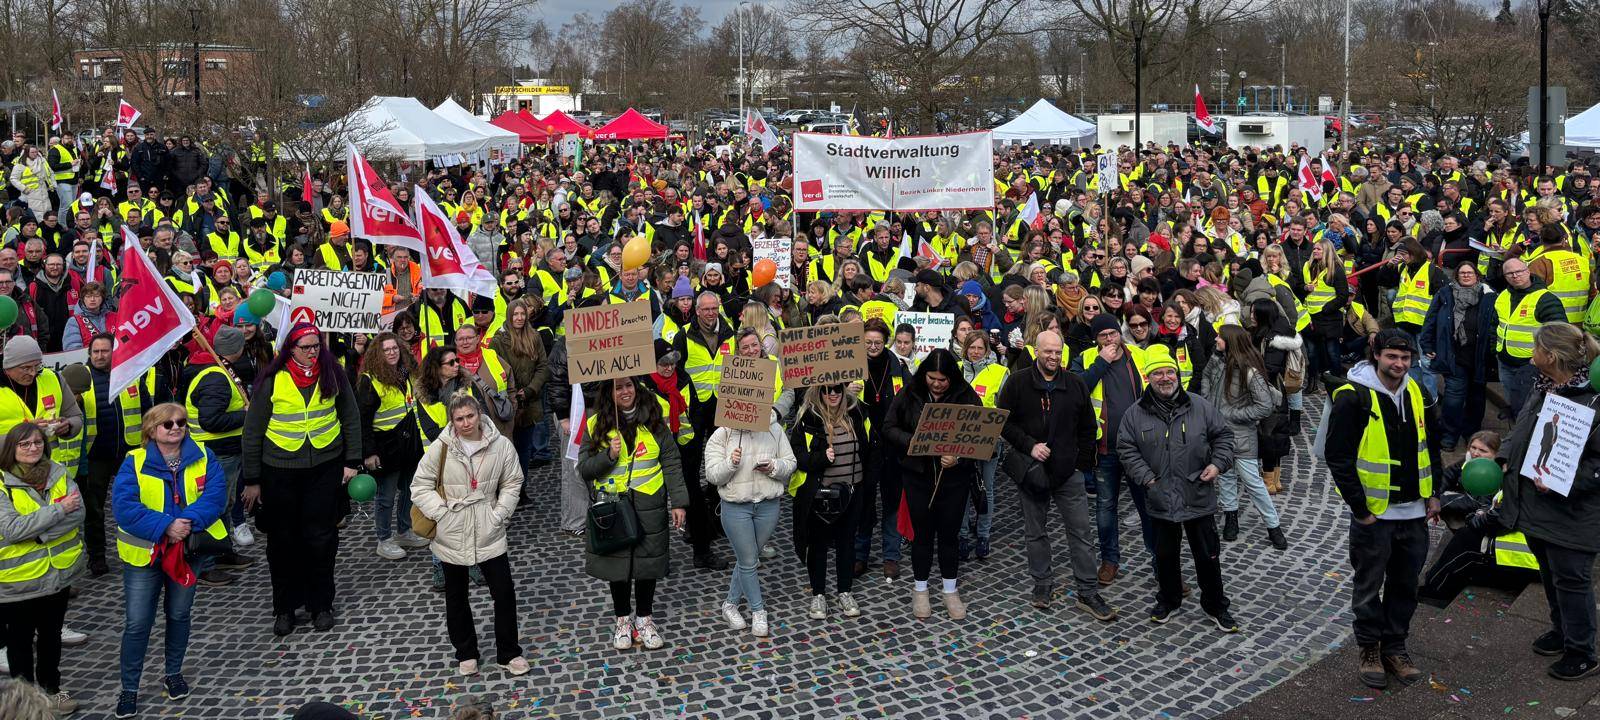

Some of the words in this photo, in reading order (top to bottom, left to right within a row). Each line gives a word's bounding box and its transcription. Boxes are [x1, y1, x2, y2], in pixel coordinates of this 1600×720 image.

[827, 143, 959, 159] Stadtverwaltung
[866, 166, 920, 179] Willich
[331, 292, 370, 309] NICHT
[572, 309, 619, 335] KINDER
[780, 330, 803, 342] MIT
[807, 326, 840, 339] EINEM
[588, 336, 623, 351] KNETE
[783, 340, 827, 355] ANGEBOT
[577, 360, 606, 376] WIR
[610, 353, 640, 373] AUCH
[732, 356, 756, 368] GUTE
[784, 356, 798, 366] ICH
[803, 352, 830, 363] HEUTE
[835, 350, 854, 360] ZUR
[724, 366, 764, 381] BILDUNG
[784, 366, 814, 380] ARBEIT
[802, 368, 864, 385] GEGANGEN
[724, 410, 759, 424] ANGEBOT
[926, 407, 952, 420] ICH
[957, 408, 982, 420] BIN
[982, 412, 1006, 424] SO
[920, 421, 956, 432] SAUER
[960, 423, 982, 432] ICH
[917, 432, 948, 442] HABE
[952, 434, 994, 445] SOGAR
[912, 444, 930, 454] EIN
[934, 444, 975, 454] SCHILD
